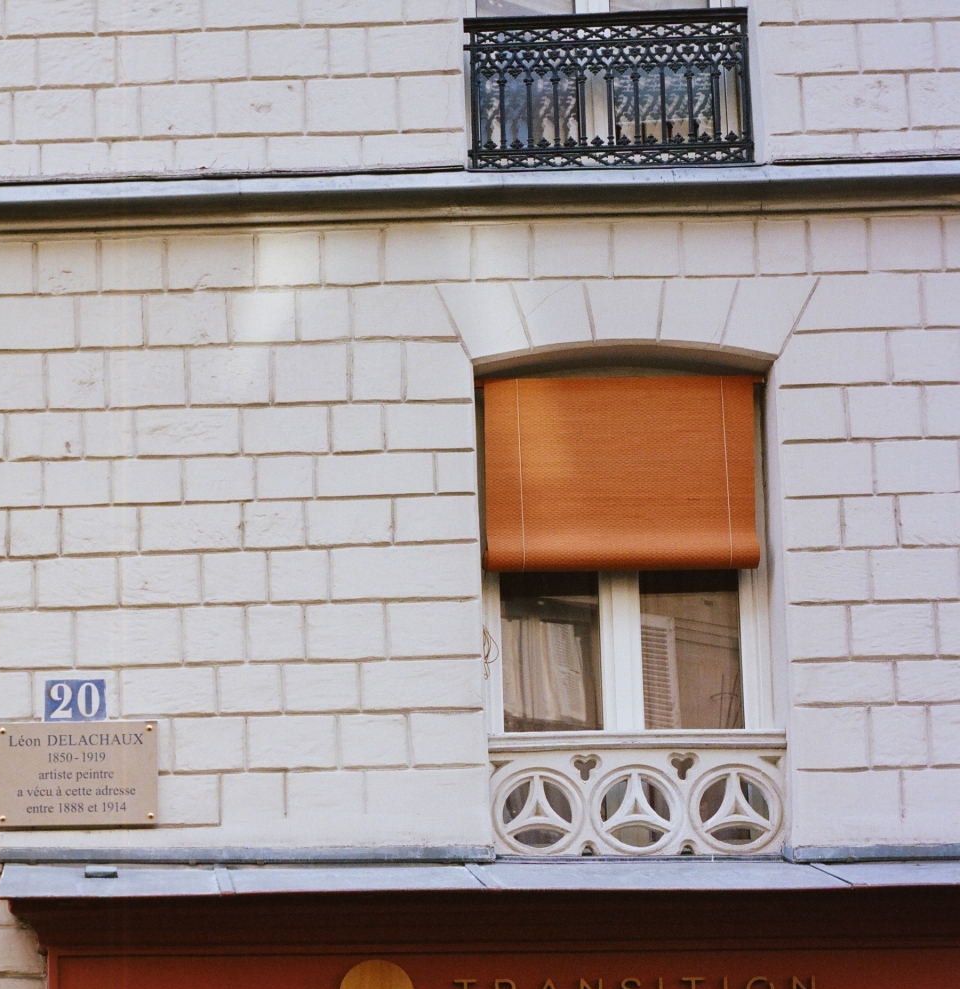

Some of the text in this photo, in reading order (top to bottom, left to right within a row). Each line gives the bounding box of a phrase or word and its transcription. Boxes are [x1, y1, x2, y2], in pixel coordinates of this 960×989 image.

[50, 682, 100, 718] 20
[9, 733, 144, 747] Léon DELACHAUX
[38, 770, 114, 782] artiste peintre
[27, 786, 52, 797] vécu
[56, 786, 62, 796] à
[66, 786, 92, 796] cette
[95, 786, 136, 796] adresse
[26, 802, 126, 814] entre 1888 et 1914
